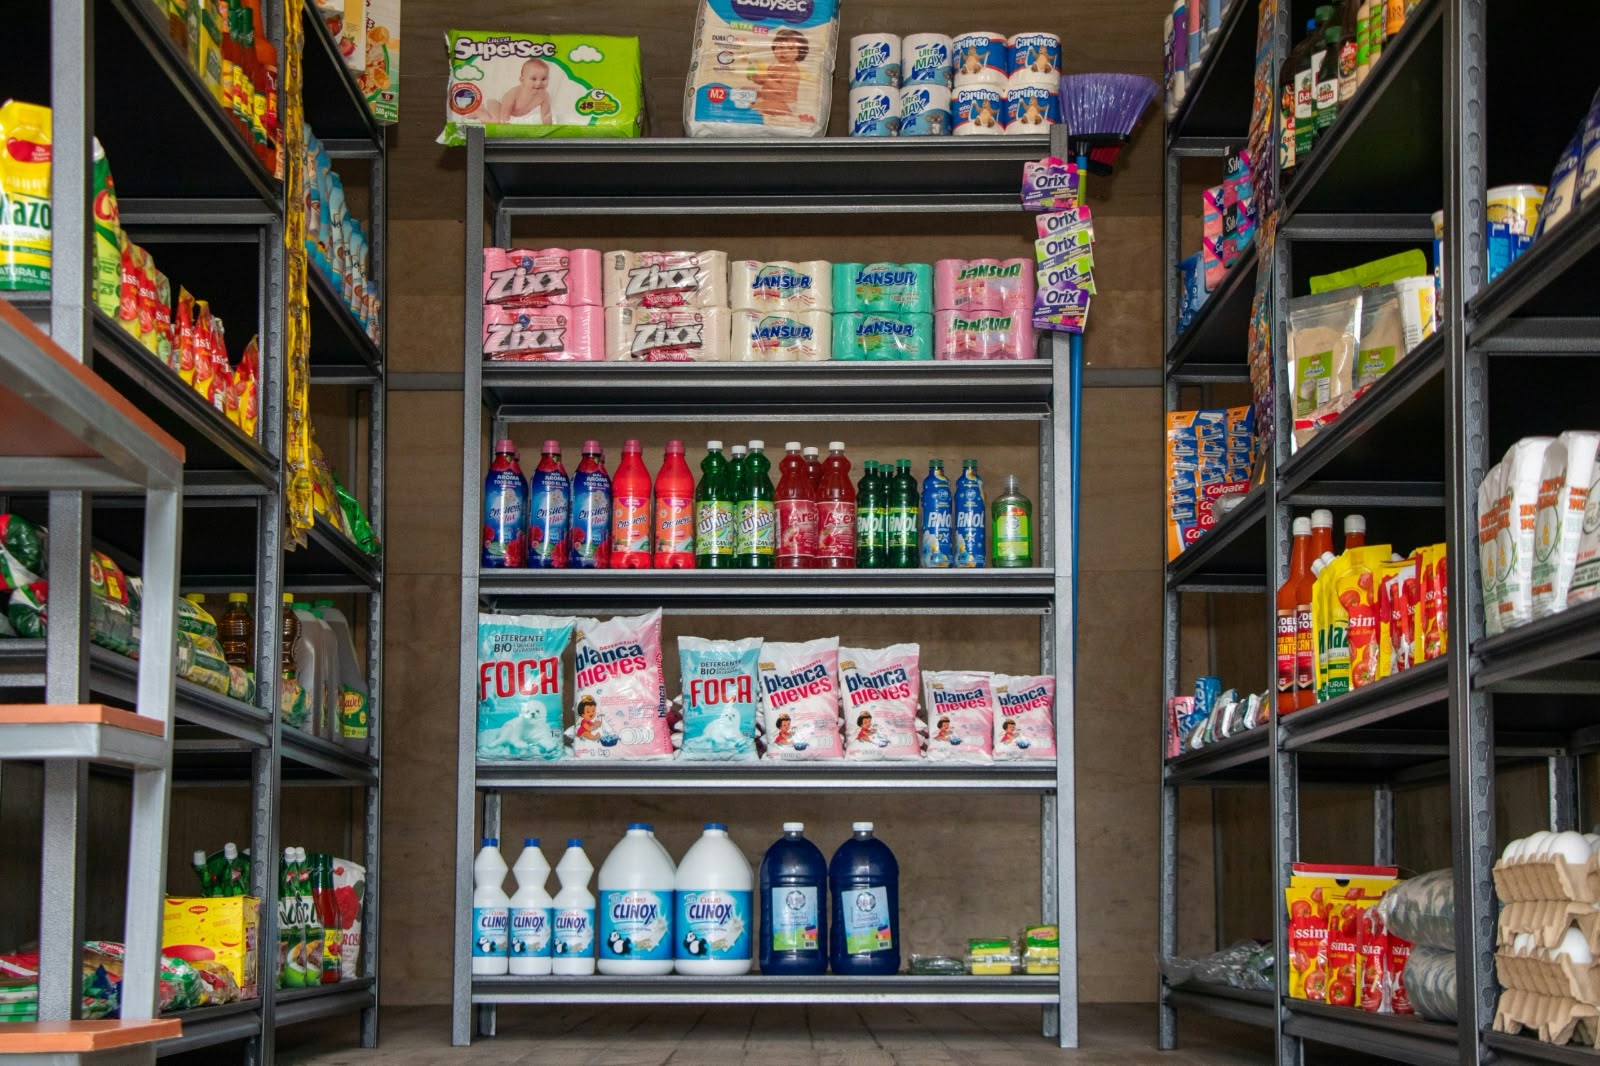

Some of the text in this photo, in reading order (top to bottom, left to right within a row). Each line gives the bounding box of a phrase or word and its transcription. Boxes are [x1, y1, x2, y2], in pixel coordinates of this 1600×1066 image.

[731, 22, 769, 34] ULTRA SEC
[454, 37, 557, 61] SuperSec
[953, 36, 989, 52] ariñoso
[1015, 35, 1058, 50] Cariñoso
[857, 53, 886, 71] MAX
[860, 46, 880, 59] Ultra
[917, 46, 939, 59] Ultra
[915, 54, 943, 71] MAX
[710, 89, 725, 100] M2
[958, 86, 1001, 102] Cariñoso
[1007, 85, 1050, 102] Cariñoso
[579, 101, 594, 111] 48
[857, 106, 886, 124] MAX
[860, 100, 880, 112] Ultra
[1035, 175, 1067, 189] Orix
[1046, 210, 1078, 231] Orix
[1046, 235, 1077, 256] Orix
[625, 264, 701, 300] Zixx
[752, 272, 813, 292] JANSUR
[855, 269, 918, 288] JANSUR
[1048, 264, 1078, 285] Orix
[485, 266, 570, 304] Zixx
[1046, 290, 1078, 304] Orix
[483, 322, 567, 354] Zixx
[752, 322, 813, 342] JANSUR
[855, 320, 915, 339] JANSUR
[631, 321, 704, 360] Zixx
[1206, 483, 1245, 497] Colgate
[699, 511, 733, 536] White
[741, 511, 775, 536] White
[1281, 617, 1297, 625] DEL
[493, 643, 512, 654] BIO
[495, 634, 545, 644] DETERGENTE
[576, 643, 644, 674] blanca
[700, 660, 742, 668] DETERGENTE
[479, 656, 560, 702] FOCA
[577, 655, 648, 690] nieves
[700, 667, 716, 675] BIO
[763, 663, 828, 695] blanca
[845, 666, 907, 692] blanca
[655, 652, 667, 719] blanca nieves
[690, 674, 752, 708] FOCA
[769, 677, 833, 709] nieves
[850, 681, 911, 707] nieves
[933, 687, 984, 705] blanca
[935, 696, 987, 715] nieves
[997, 685, 1047, 707] blanca
[1001, 694, 1050, 717] nieves
[613, 902, 657, 925] CLINOX
[688, 902, 733, 925] CLINOX
[513, 915, 545, 932] CLINOX
[556, 915, 588, 933] CLINOX
